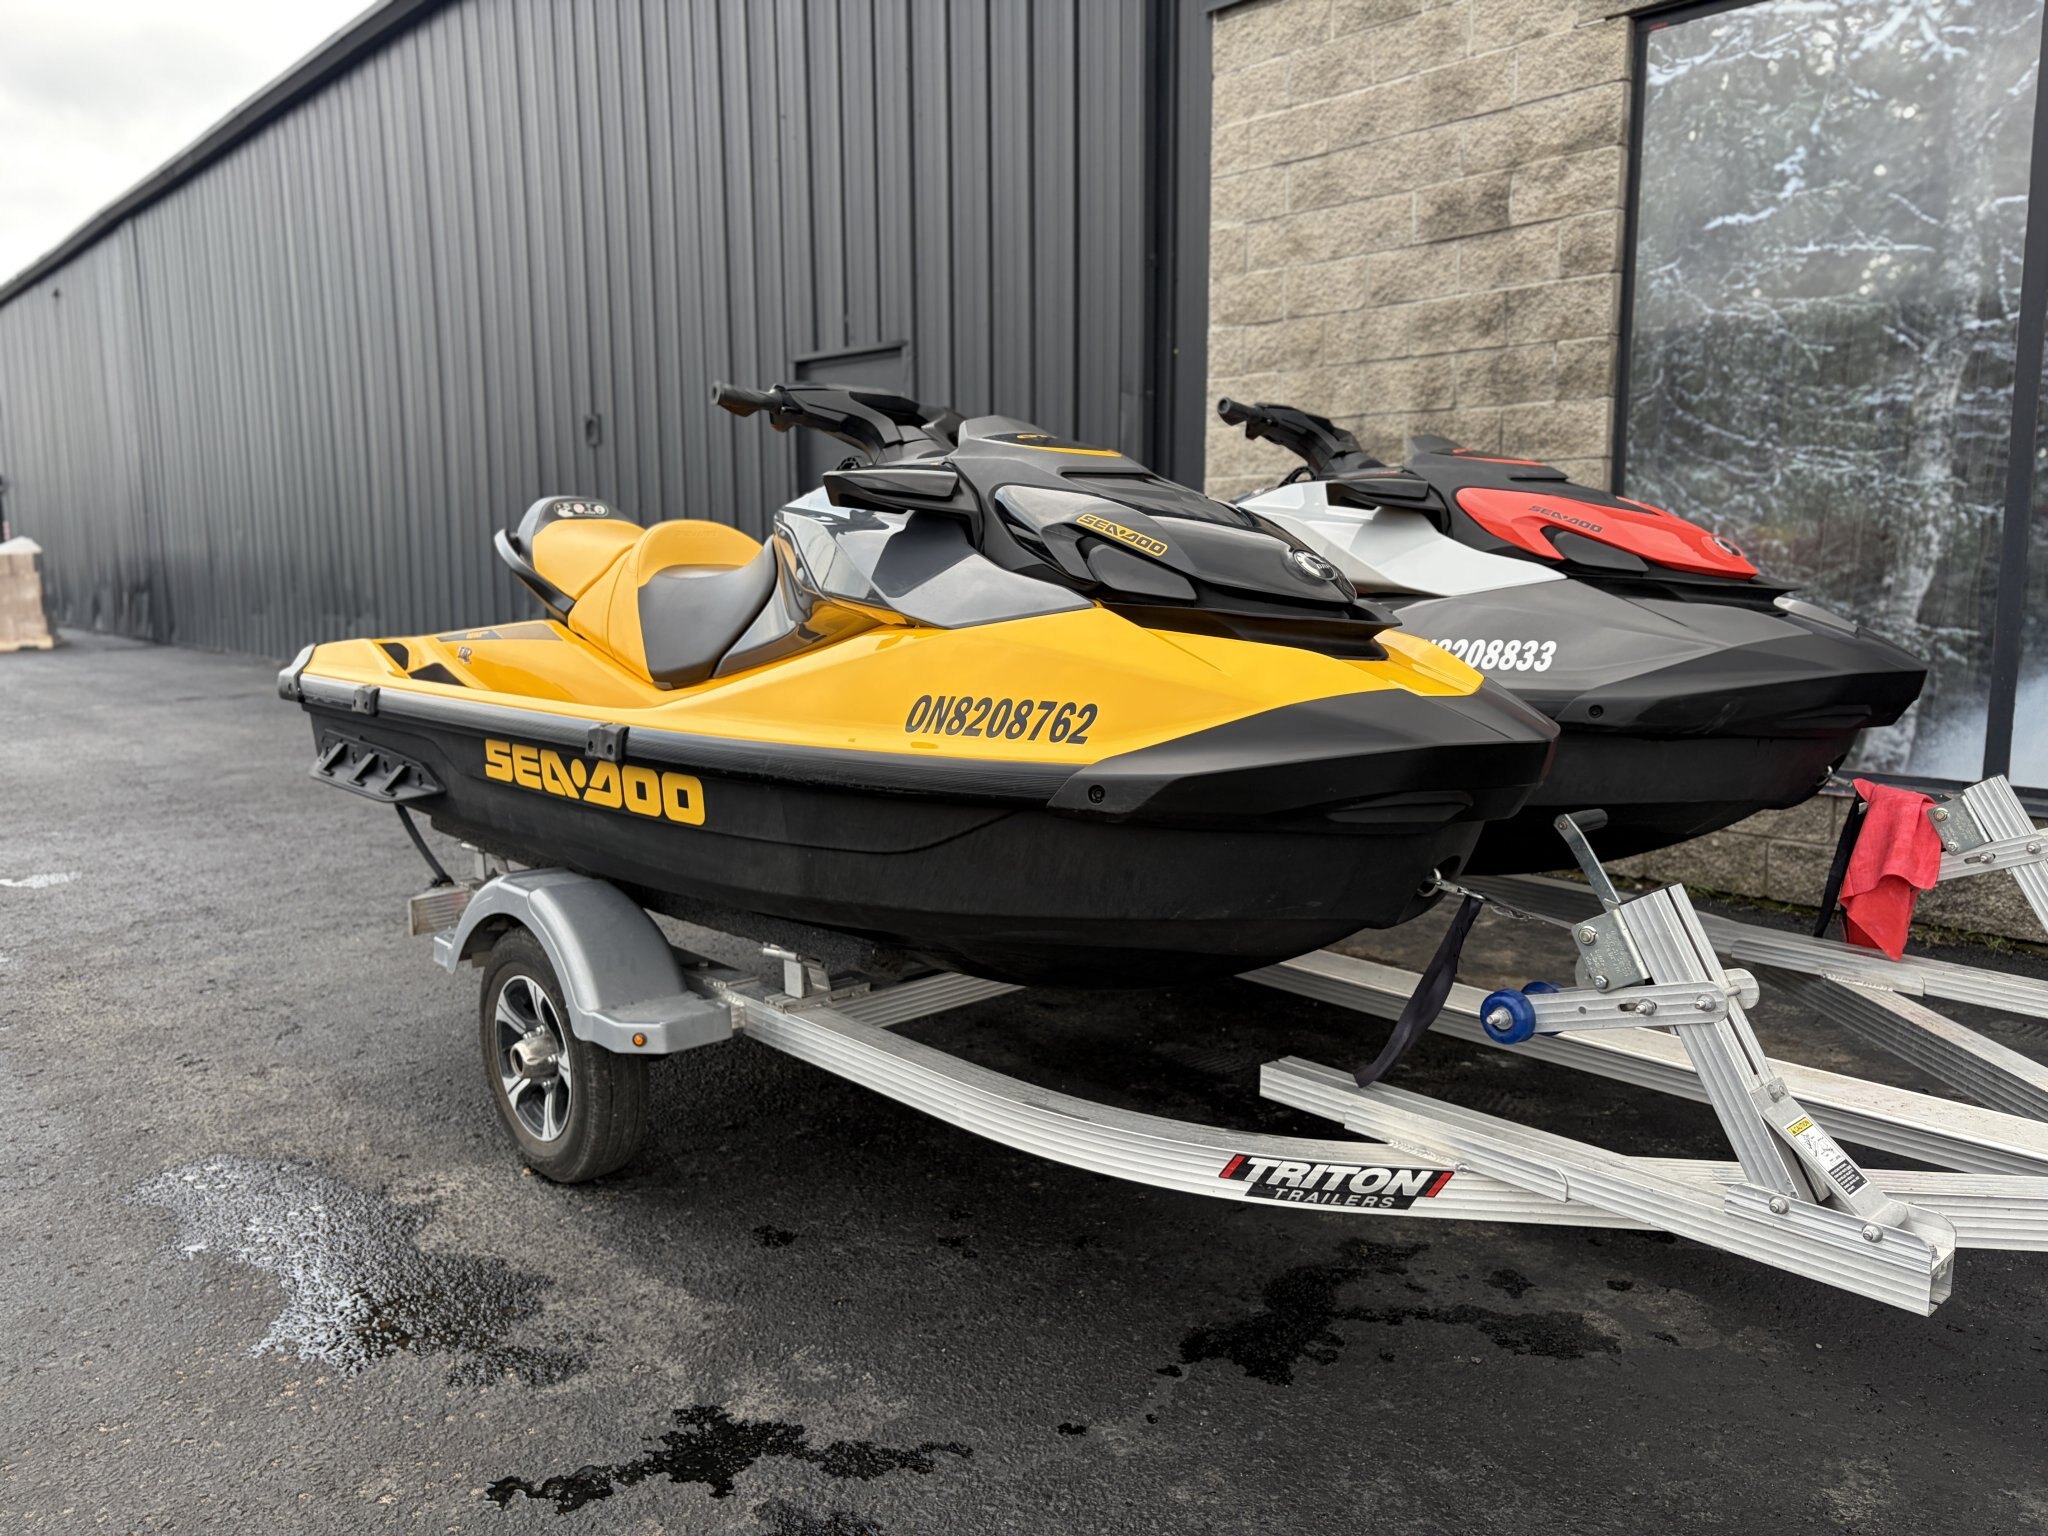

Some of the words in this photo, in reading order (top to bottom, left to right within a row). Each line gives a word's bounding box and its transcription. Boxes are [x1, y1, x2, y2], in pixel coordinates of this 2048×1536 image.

[905, 694, 1098, 744] ON8208762
[1244, 1156, 1433, 1197] TRITON
[1273, 1187, 1395, 1209] TRAILERS
